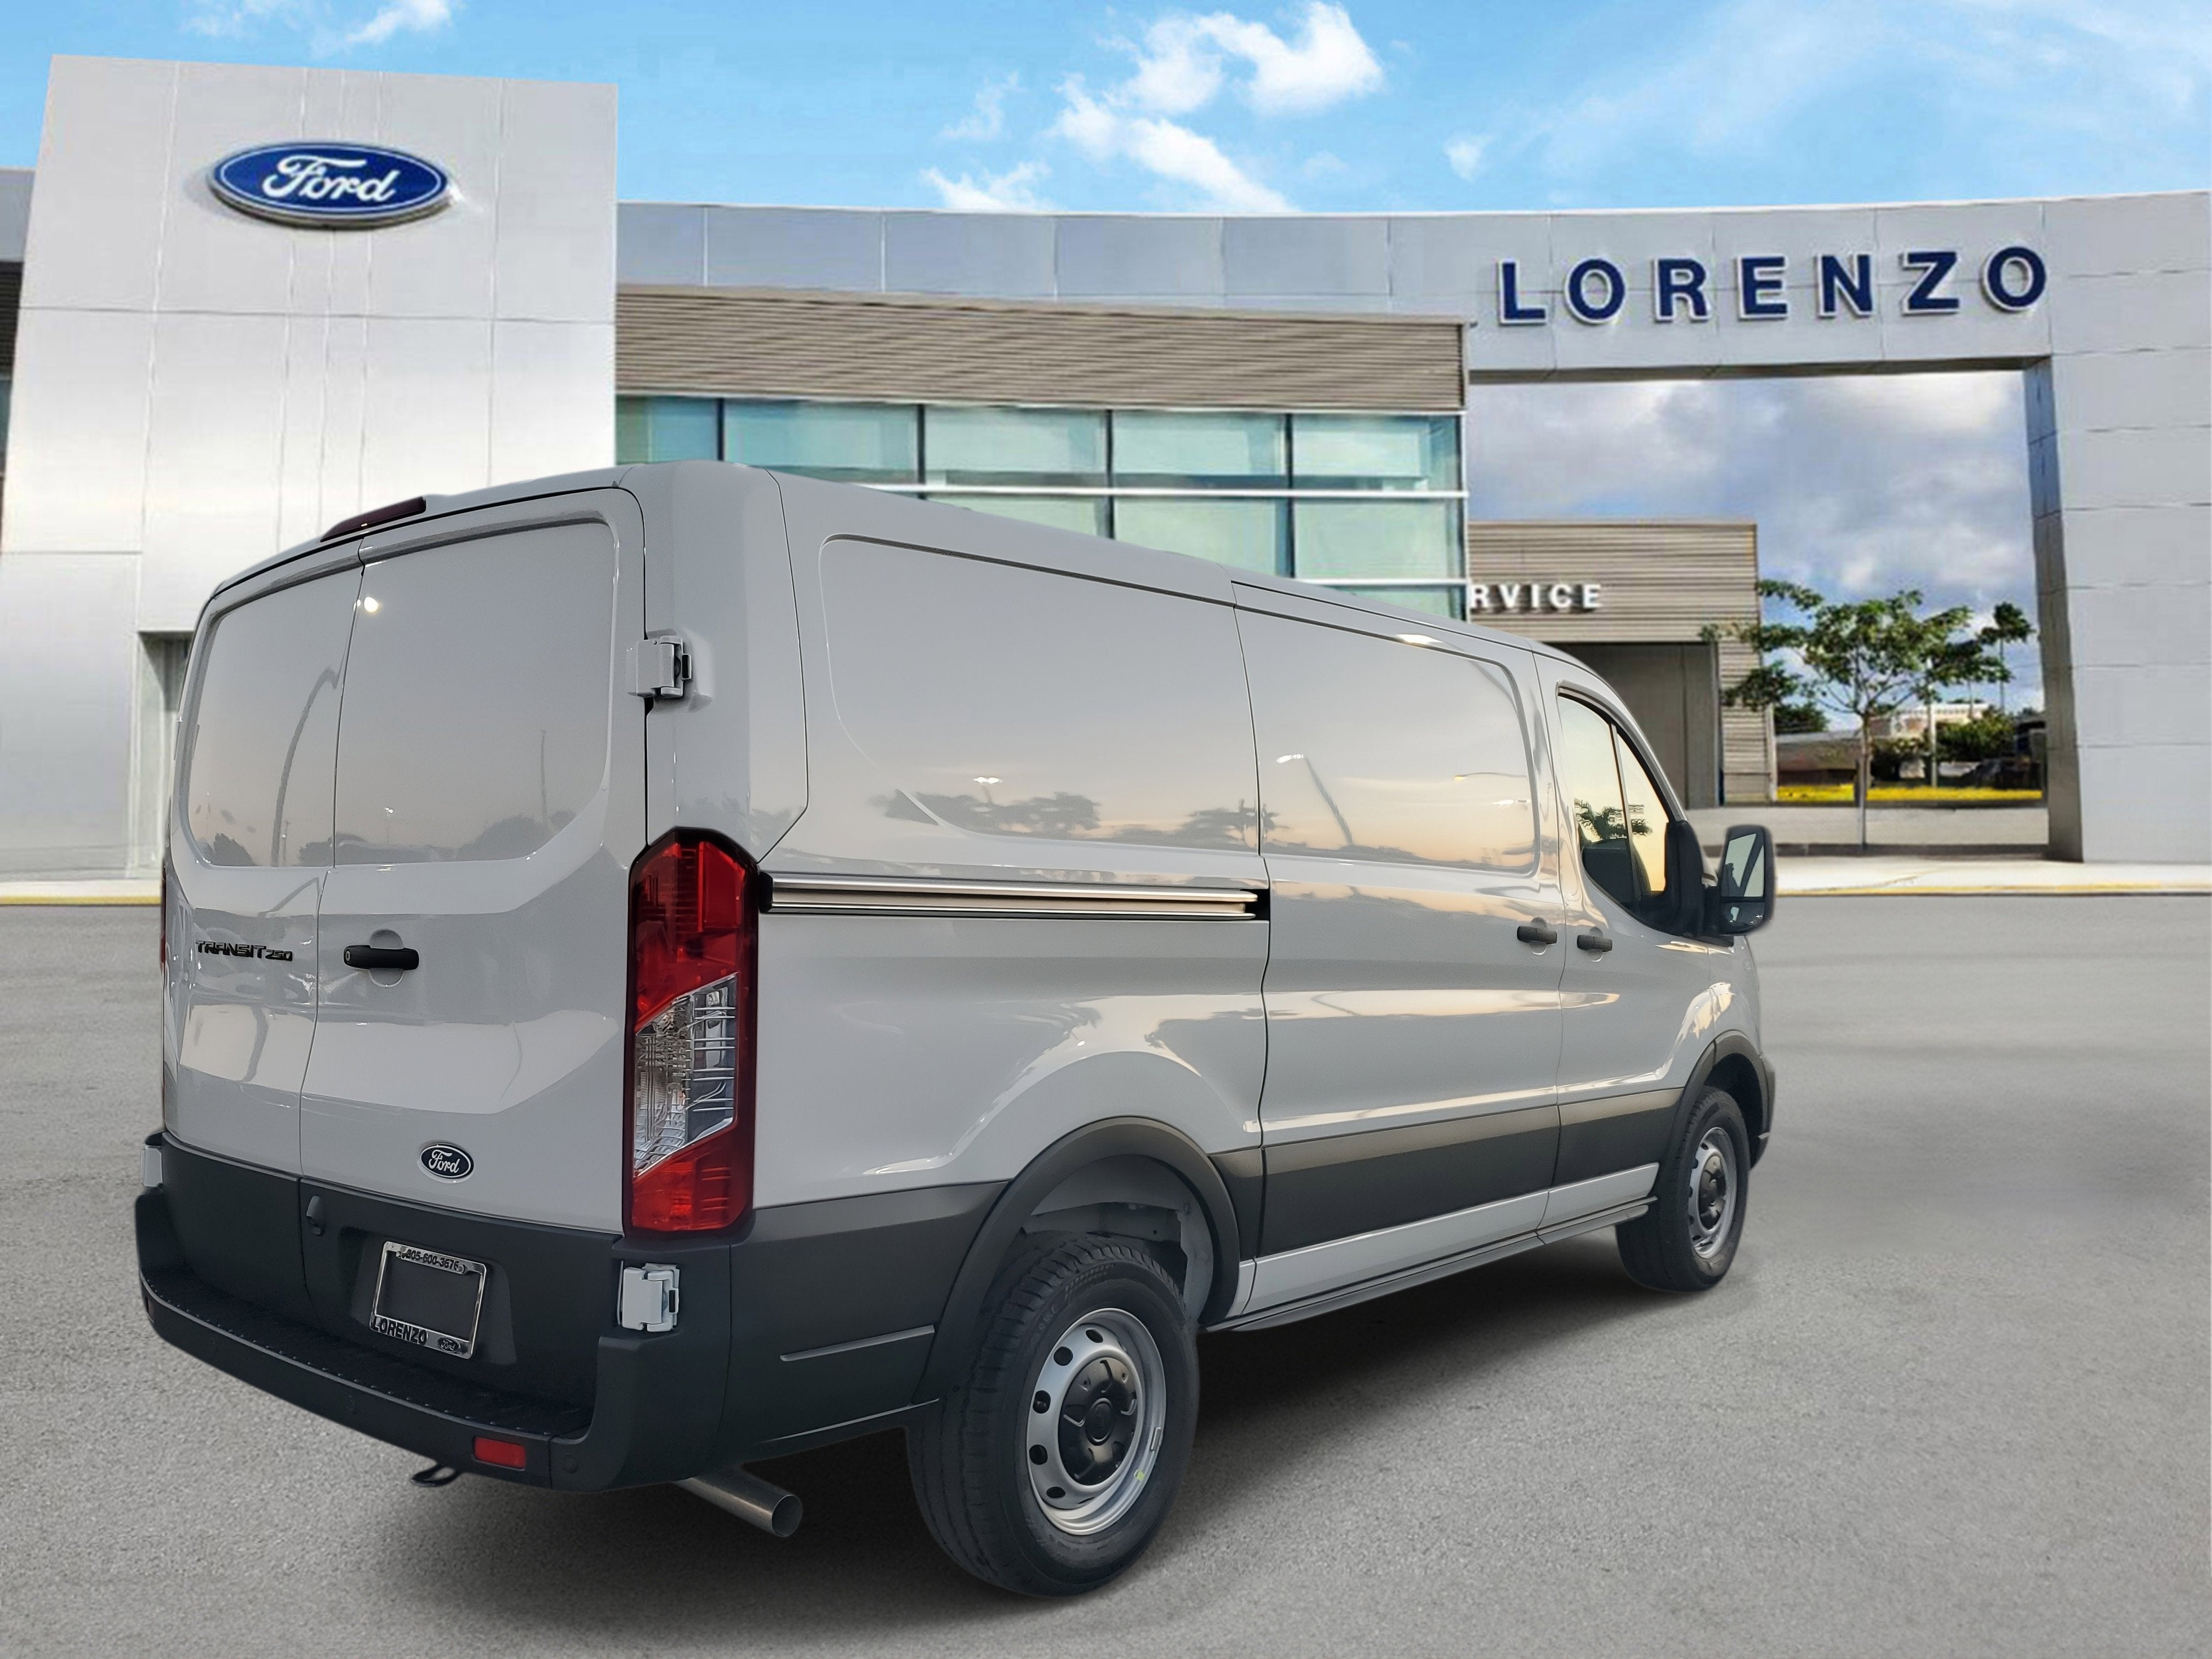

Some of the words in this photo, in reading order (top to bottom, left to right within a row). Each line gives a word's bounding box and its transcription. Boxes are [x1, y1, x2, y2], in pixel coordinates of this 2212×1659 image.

[262, 154, 401, 202] Ford
[1498, 245, 2048, 326] LORENZO
[195, 940, 267, 959] TRANSIT
[265, 949, 293, 961] 250
[429, 1149, 460, 1173] Ford
[373, 1316, 427, 1346] LORENZO
